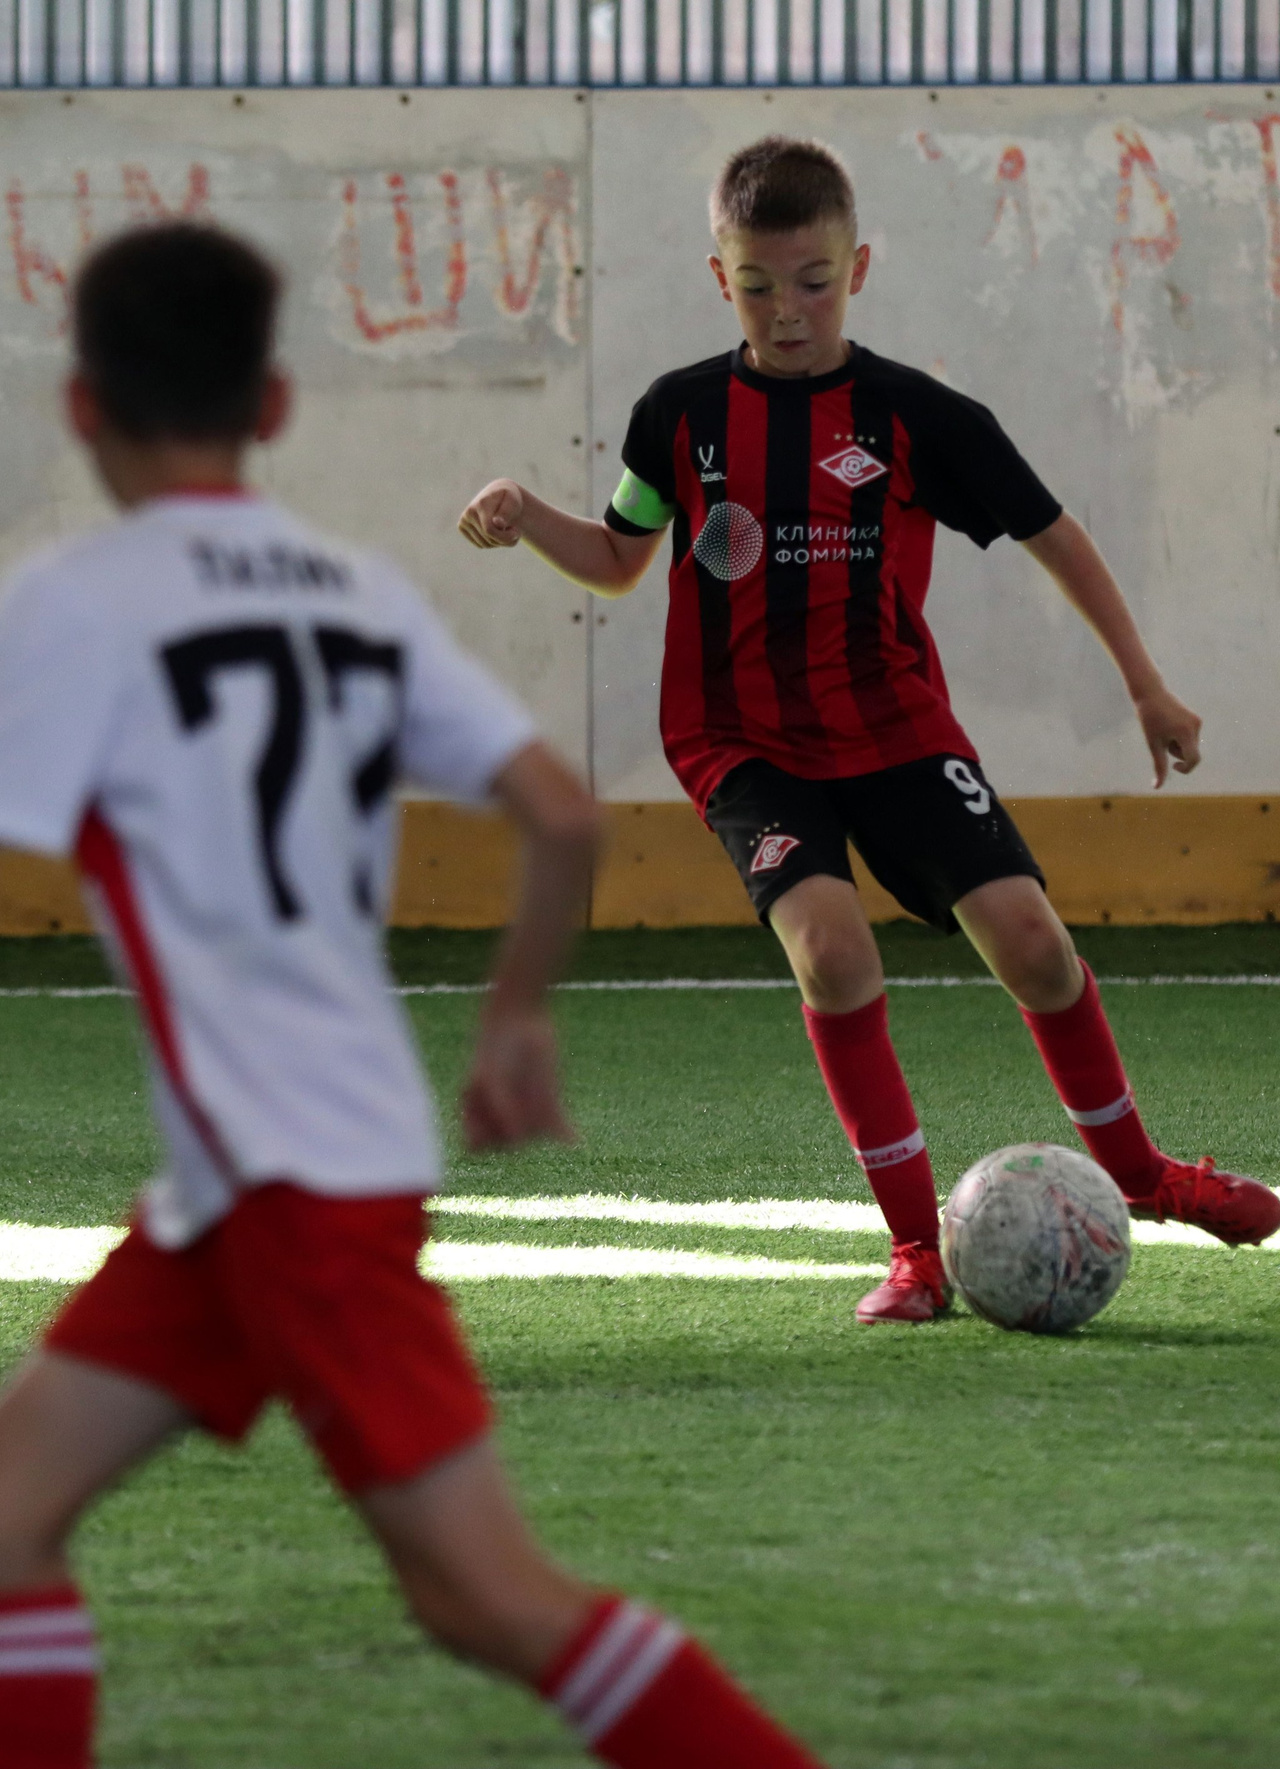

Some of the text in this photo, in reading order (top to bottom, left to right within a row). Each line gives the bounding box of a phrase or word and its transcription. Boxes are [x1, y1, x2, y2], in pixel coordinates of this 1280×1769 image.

[776, 525, 881, 541] КЛИНИКА
[775, 547, 876, 564] ФОМИНА
[158, 618, 404, 922] 77
[943, 759, 991, 815] 9
